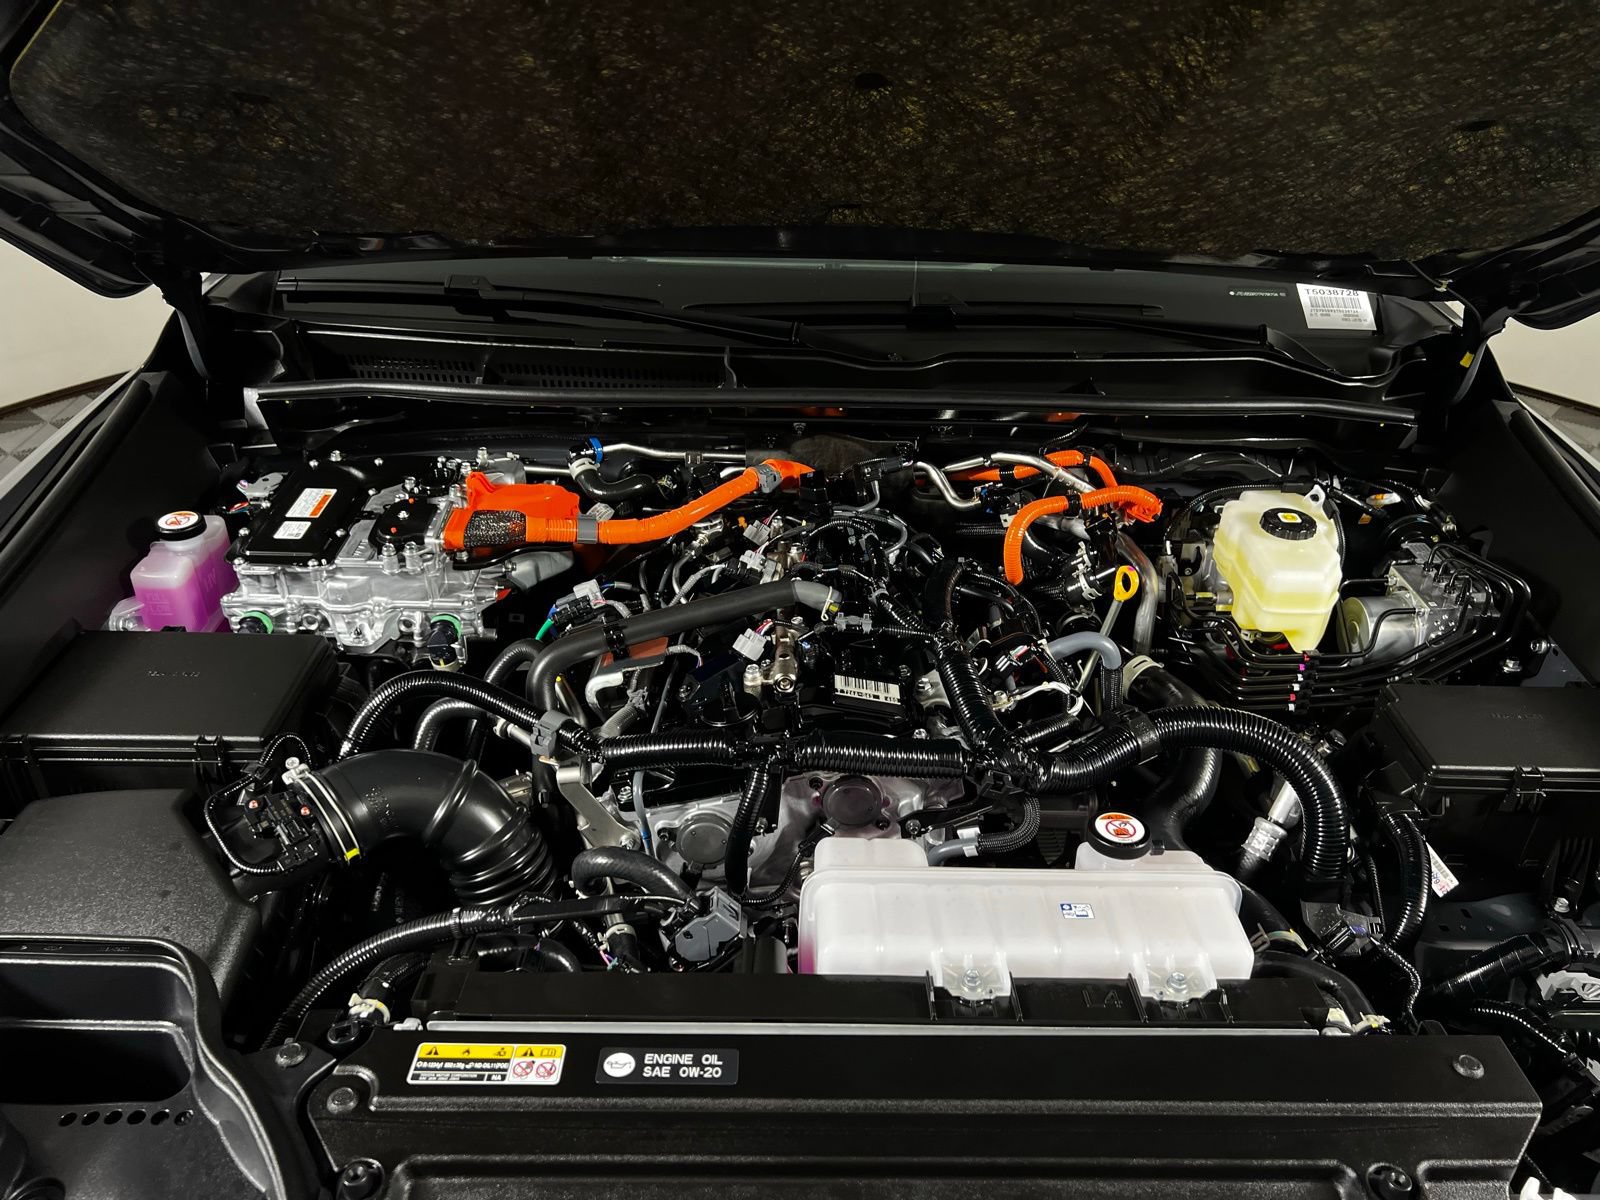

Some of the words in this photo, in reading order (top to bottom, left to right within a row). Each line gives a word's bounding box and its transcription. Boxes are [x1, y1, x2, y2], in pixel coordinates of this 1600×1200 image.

[1304, 288, 1359, 297] T5038728
[644, 1053, 693, 1065] ENGINE
[701, 1054, 723, 1065] OIL
[642, 1066, 671, 1078] SAE
[679, 1066, 722, 1078] 0W-20
